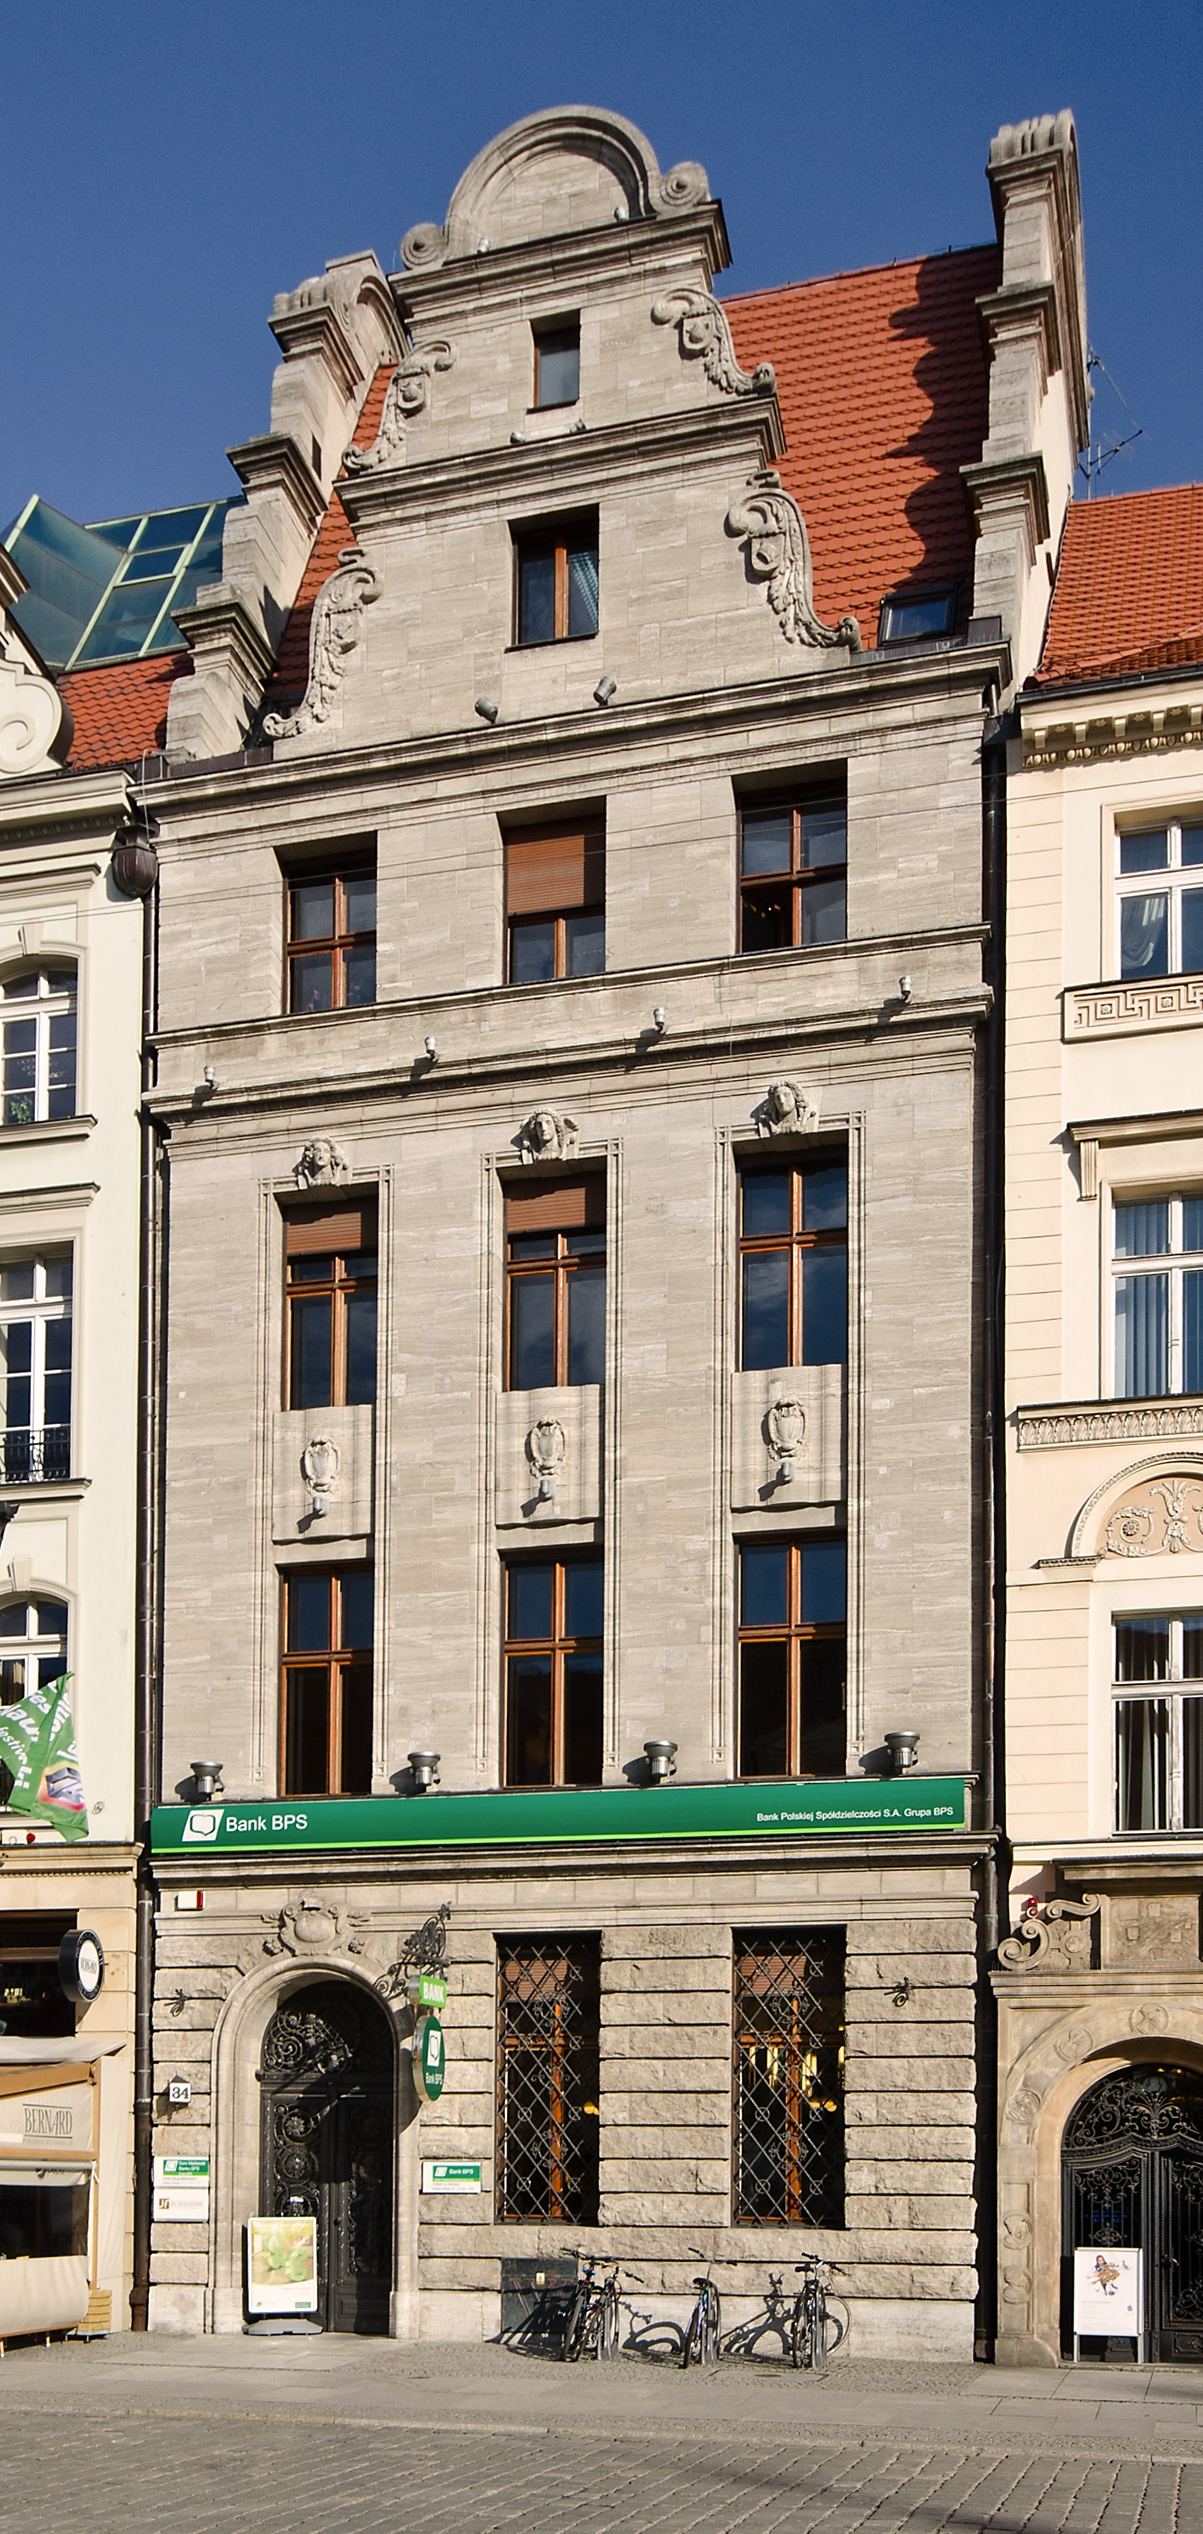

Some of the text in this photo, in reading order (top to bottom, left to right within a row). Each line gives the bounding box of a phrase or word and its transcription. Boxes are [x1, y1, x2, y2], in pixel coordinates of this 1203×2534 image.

[225, 1814, 308, 1832] Bank BPS
[757, 1807, 954, 1822] Bank Polskiej Spółdzielczości S.A. Grupa BPS
[423, 1981, 445, 2003] BANK
[171, 2086, 190, 2099] 34
[24, 2108, 73, 2135] BERNARD
